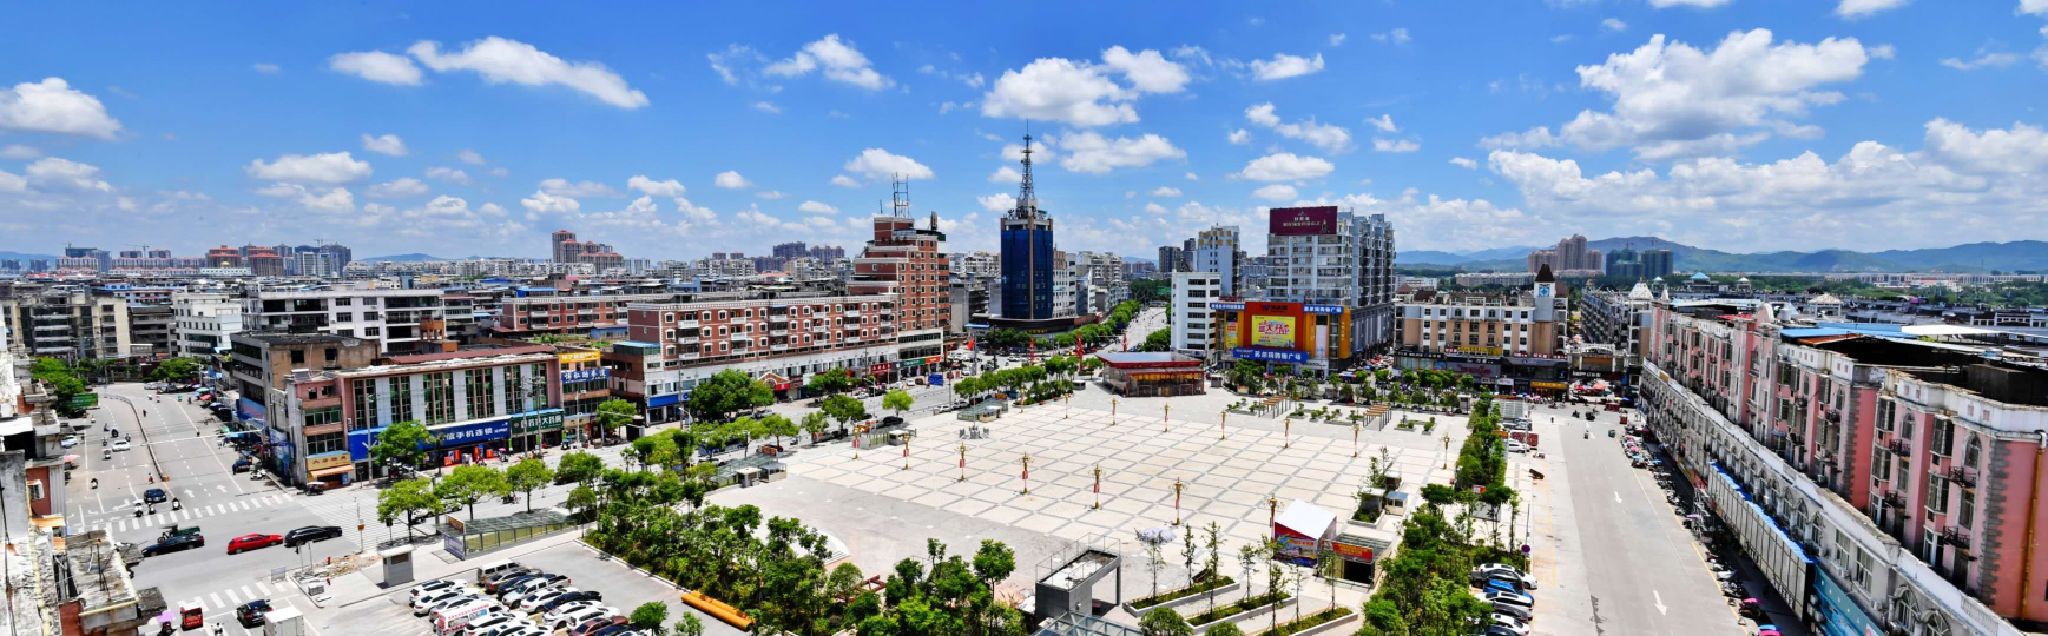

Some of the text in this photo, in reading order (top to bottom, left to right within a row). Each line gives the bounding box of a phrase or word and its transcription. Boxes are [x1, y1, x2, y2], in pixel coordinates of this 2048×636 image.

[442, 427, 493, 440] 信手机连锁
